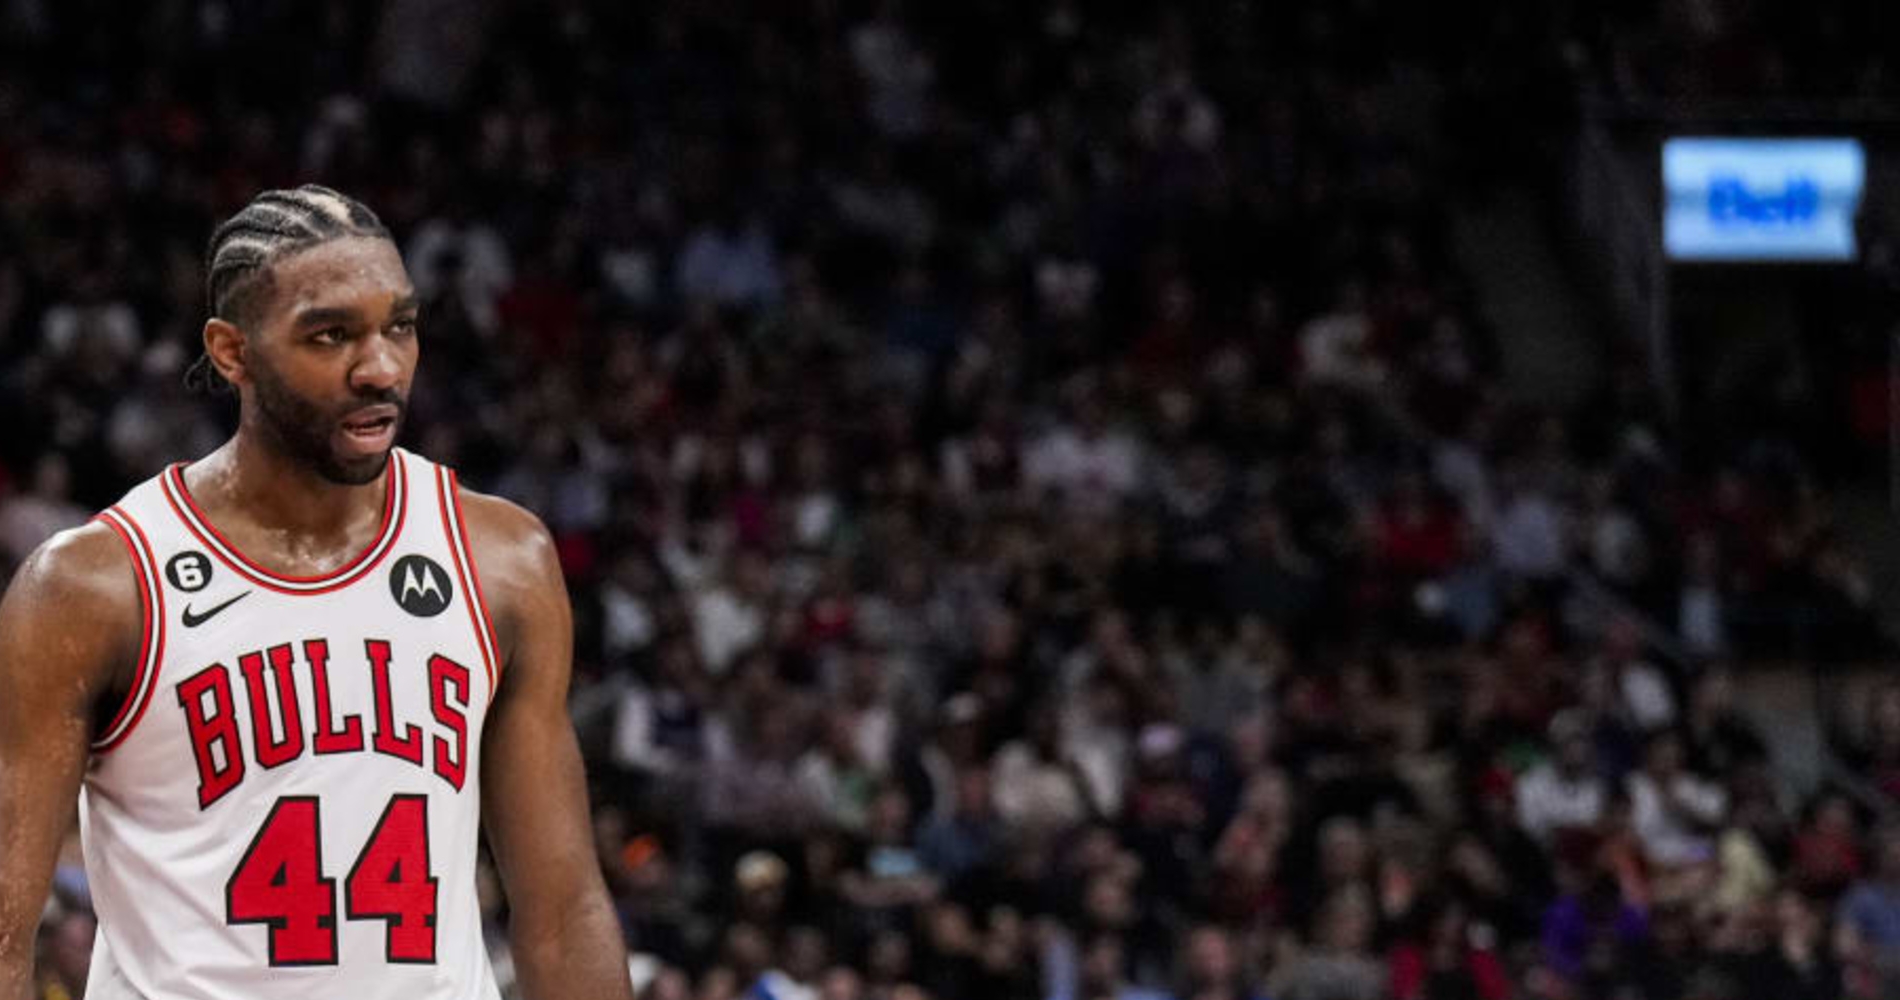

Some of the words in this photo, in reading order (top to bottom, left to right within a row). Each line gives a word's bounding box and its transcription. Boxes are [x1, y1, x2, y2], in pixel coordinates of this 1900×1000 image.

[175, 556, 204, 589] 6
[175, 638, 470, 812] BULLS
[226, 793, 439, 967] 44
